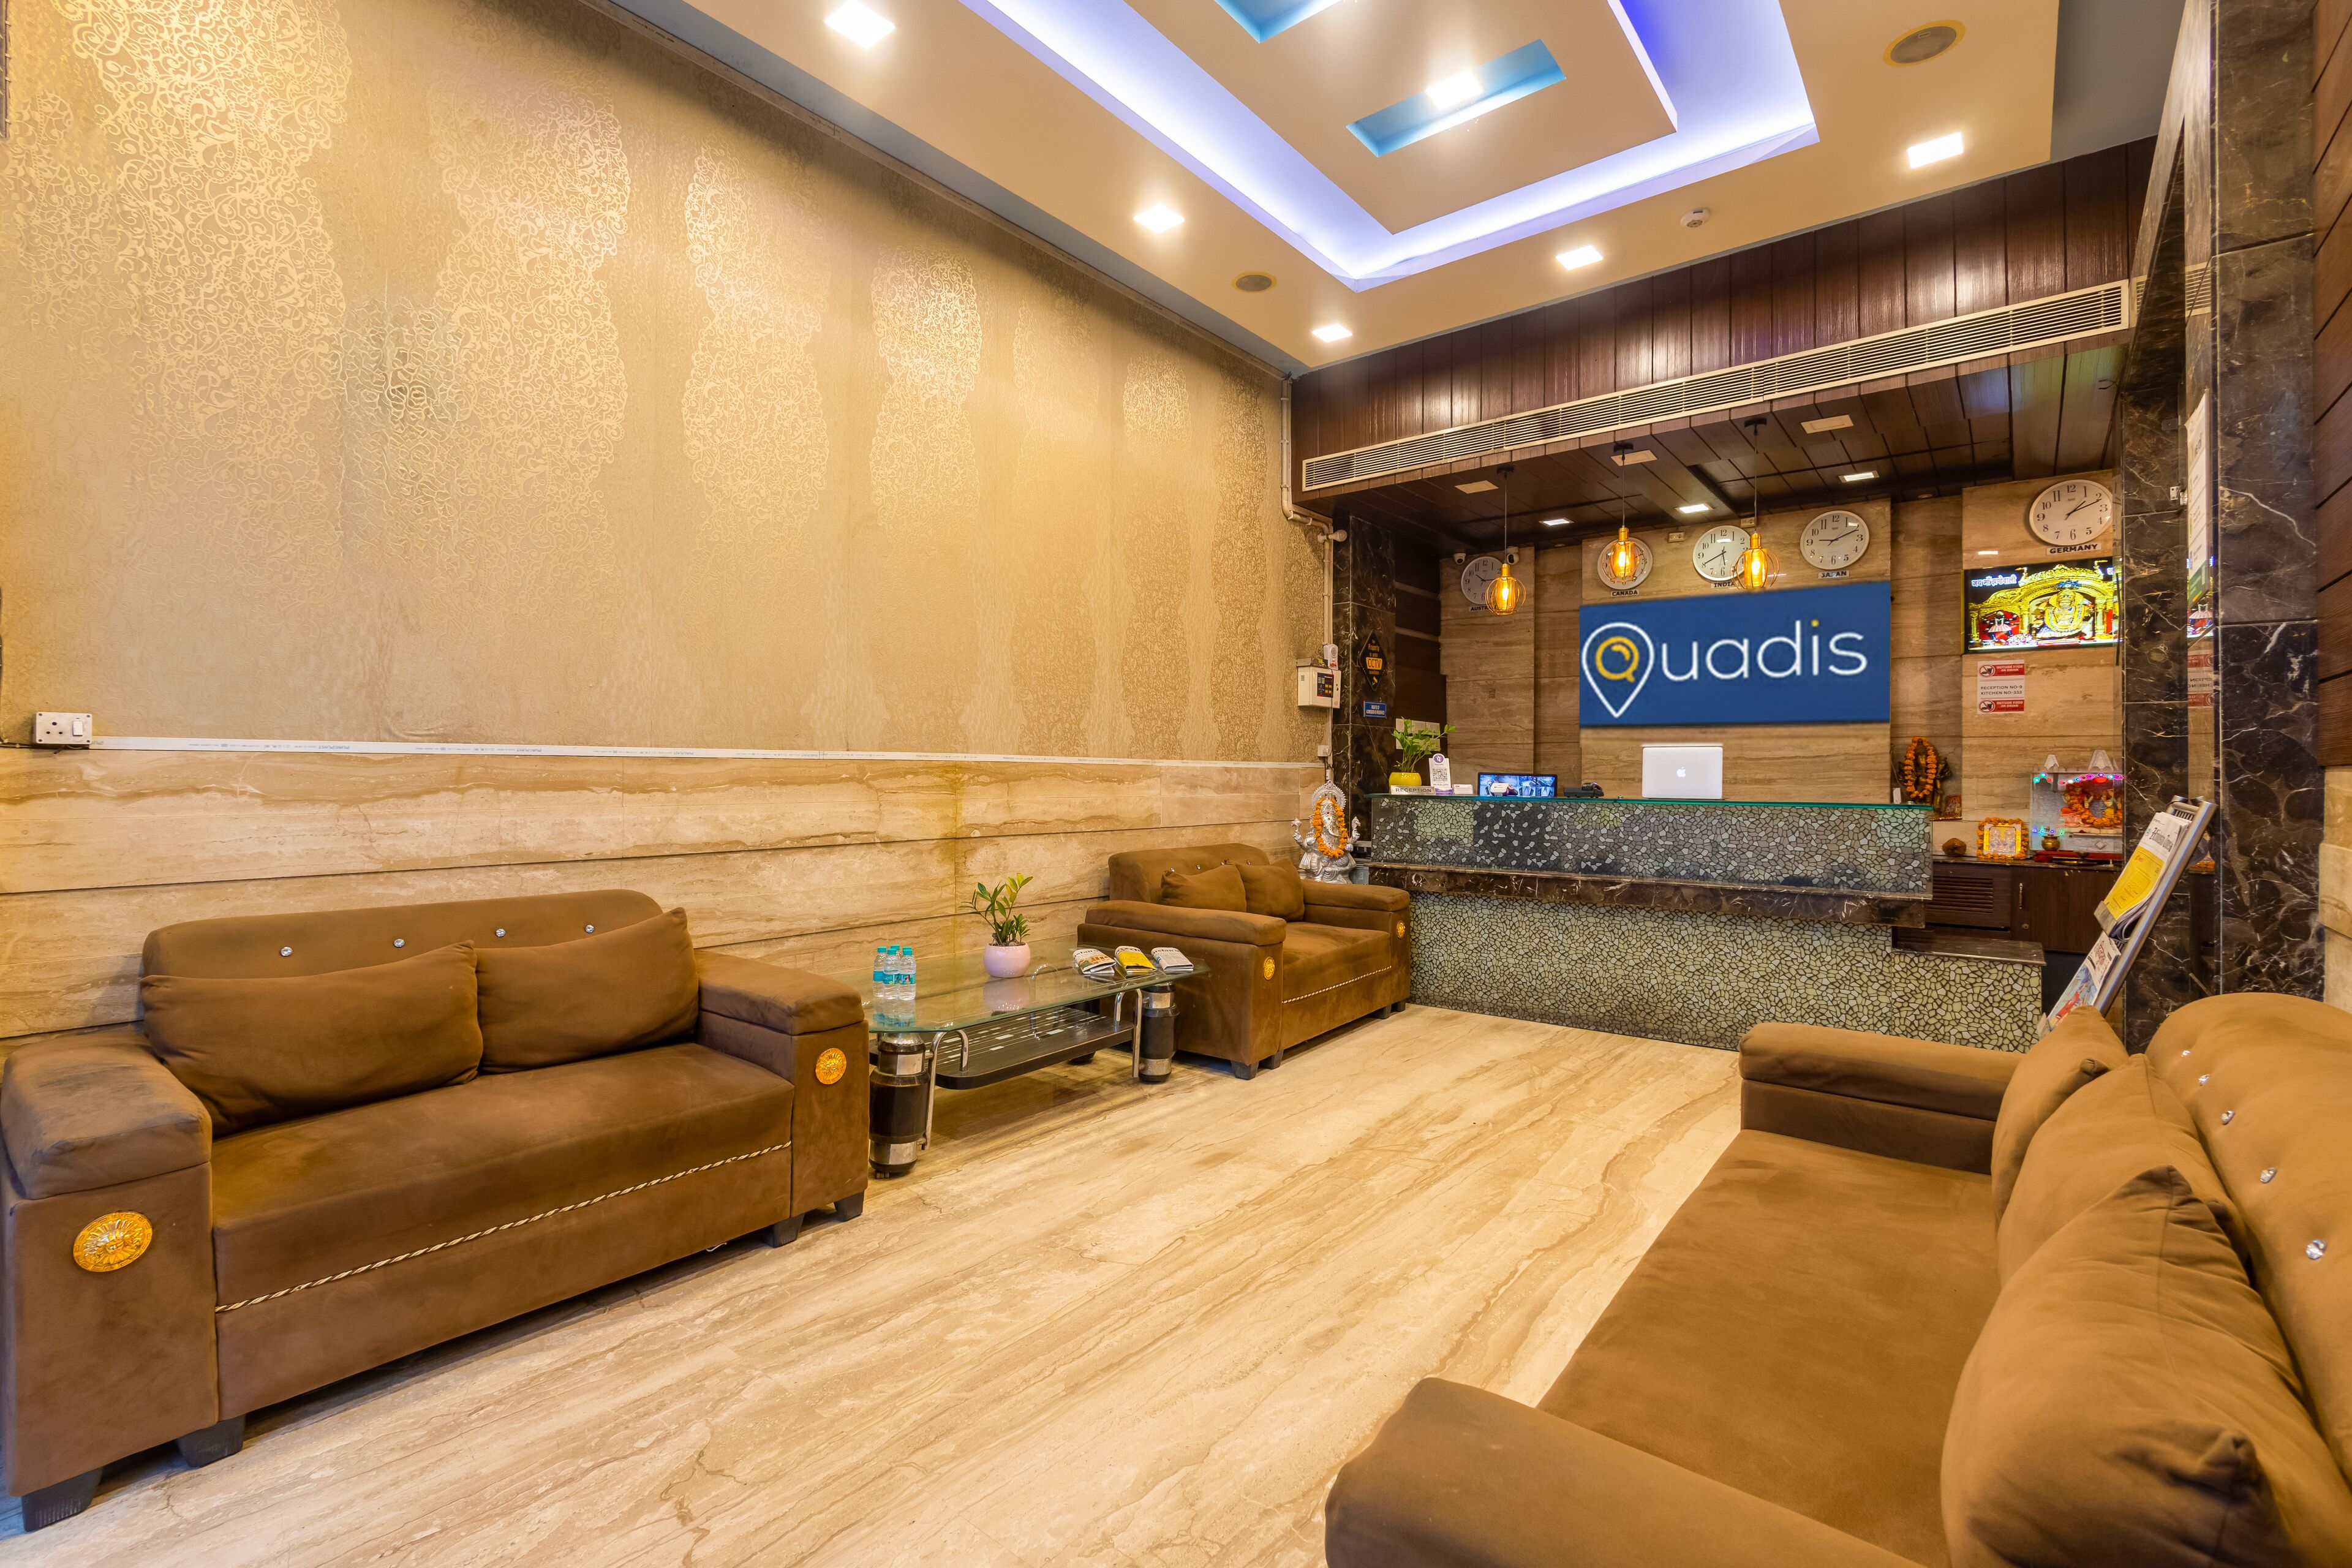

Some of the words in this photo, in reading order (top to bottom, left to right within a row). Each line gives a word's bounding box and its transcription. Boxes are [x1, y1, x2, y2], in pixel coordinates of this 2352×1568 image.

[2067, 484, 2076, 493] 12
[2053, 490, 2060, 502] 11
[1820, 519, 1827, 530] 11
[1710, 533, 1716, 543] 11
[2070, 529, 2076, 540] 6
[2049, 544, 2098, 554] GERMANY
[1831, 555, 1836, 565] 6
[1721, 567, 1725, 576] 6
[1367, 658, 1381, 668] CCTV
[1582, 620, 1867, 718] Quadis
